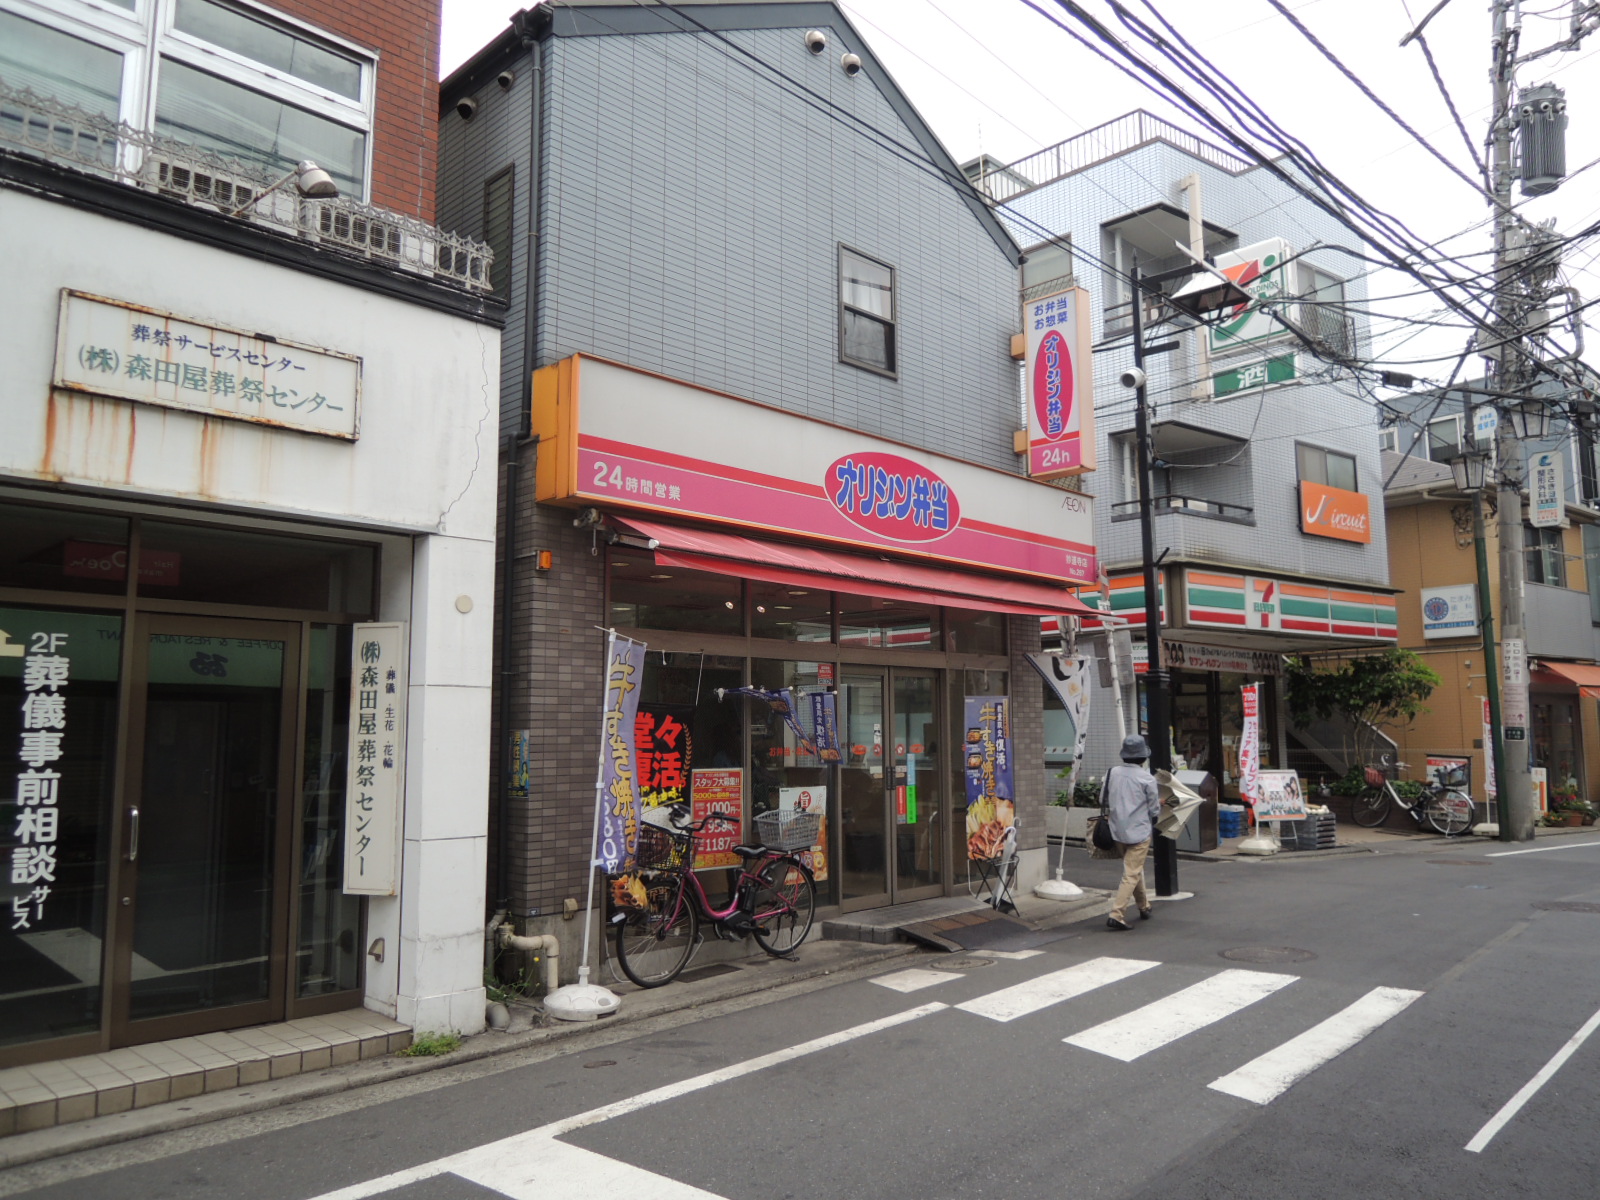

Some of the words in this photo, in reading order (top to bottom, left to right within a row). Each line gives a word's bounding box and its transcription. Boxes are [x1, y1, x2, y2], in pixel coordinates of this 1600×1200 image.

[1034, 297, 1067, 316] お弁当
[1035, 311, 1068, 330] お惣菜
[132, 324, 306, 373] 葬祭サービスセンター
[1044, 336, 1062, 434] オリジン弁当
[1237, 366, 1268, 390] 酒
[1042, 448, 1070, 467] 24h
[593, 461, 682, 502] 24時間営業
[836, 458, 949, 531] オリジン弁当
[30, 632, 69, 653] 2F
[11, 654, 70, 884] 葬儀事前相談
